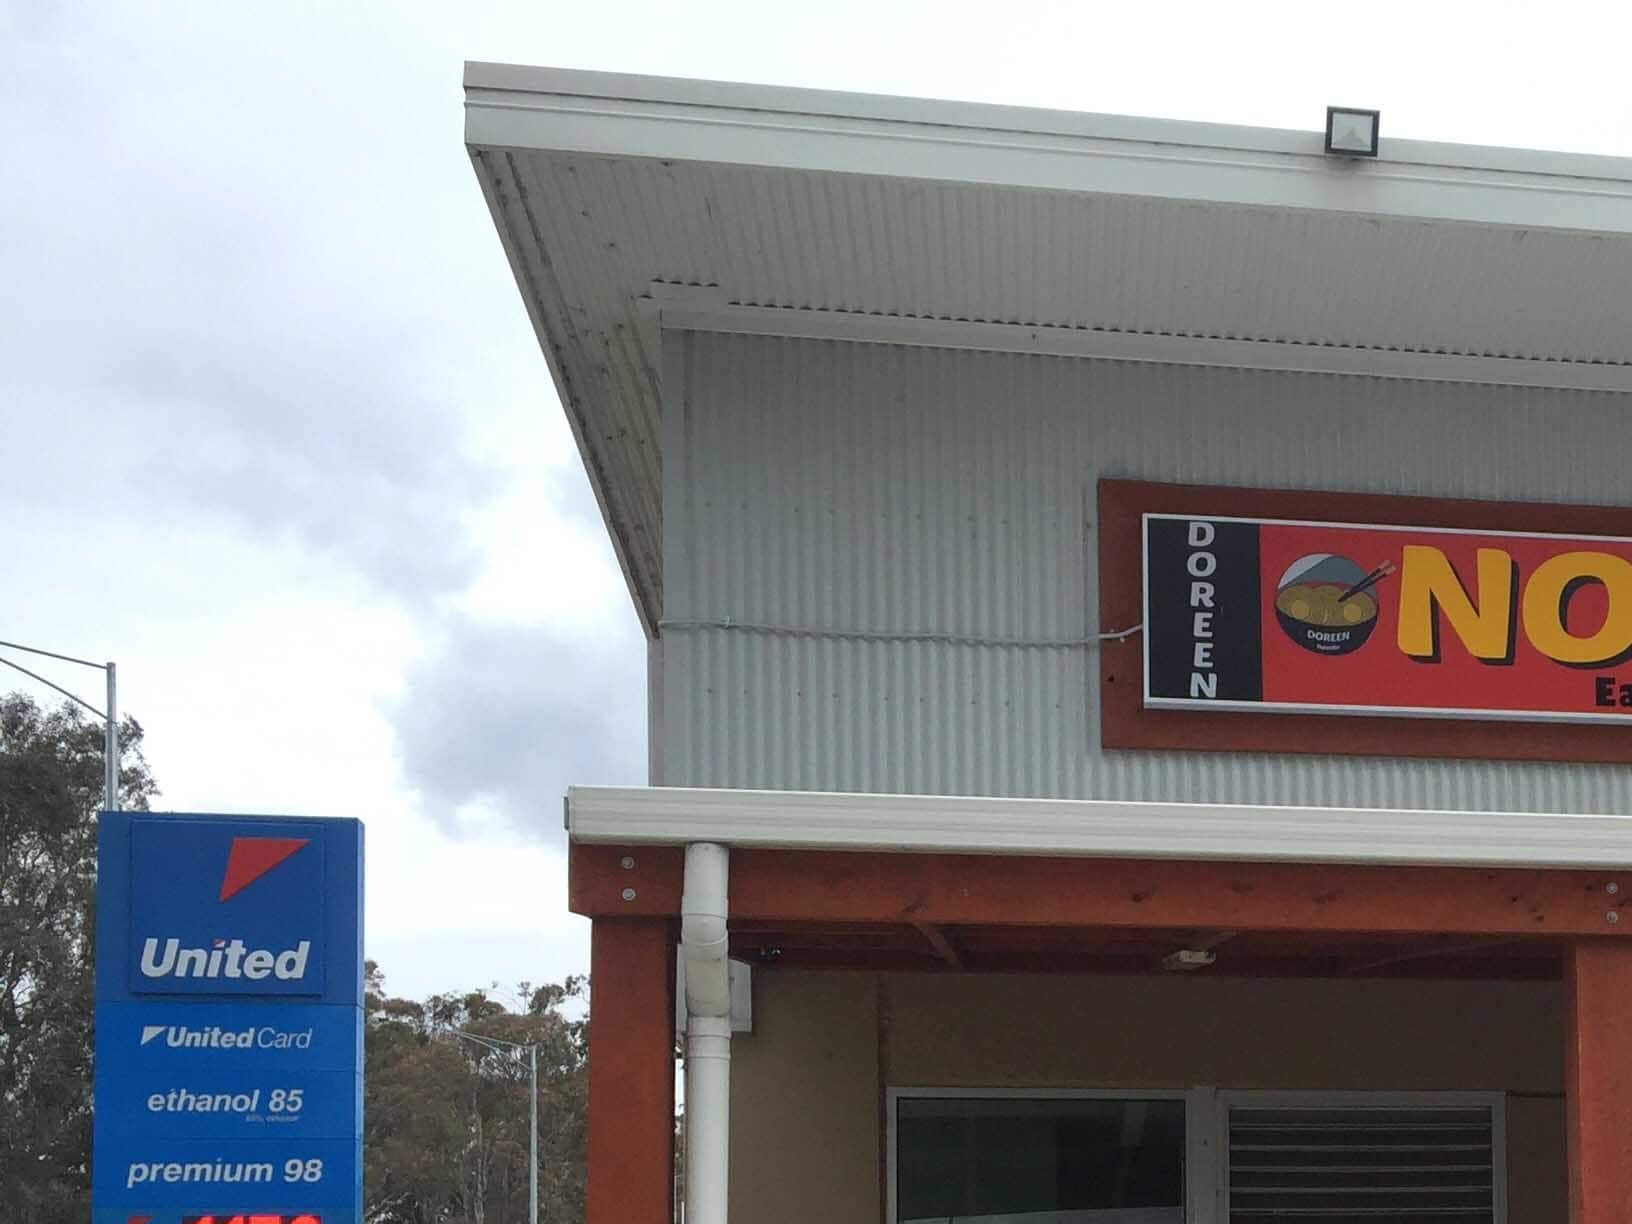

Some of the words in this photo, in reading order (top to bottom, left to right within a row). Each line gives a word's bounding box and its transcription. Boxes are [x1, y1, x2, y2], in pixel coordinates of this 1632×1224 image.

[1187, 521, 1217, 698] DOREEN
[1306, 629, 1351, 642] DOREEN
[141, 938, 311, 980] United
[147, 1088, 260, 1112] ethanol
[268, 1089, 304, 1112] 85
[127, 1157, 273, 1189] premium
[284, 1158, 323, 1182] 98
